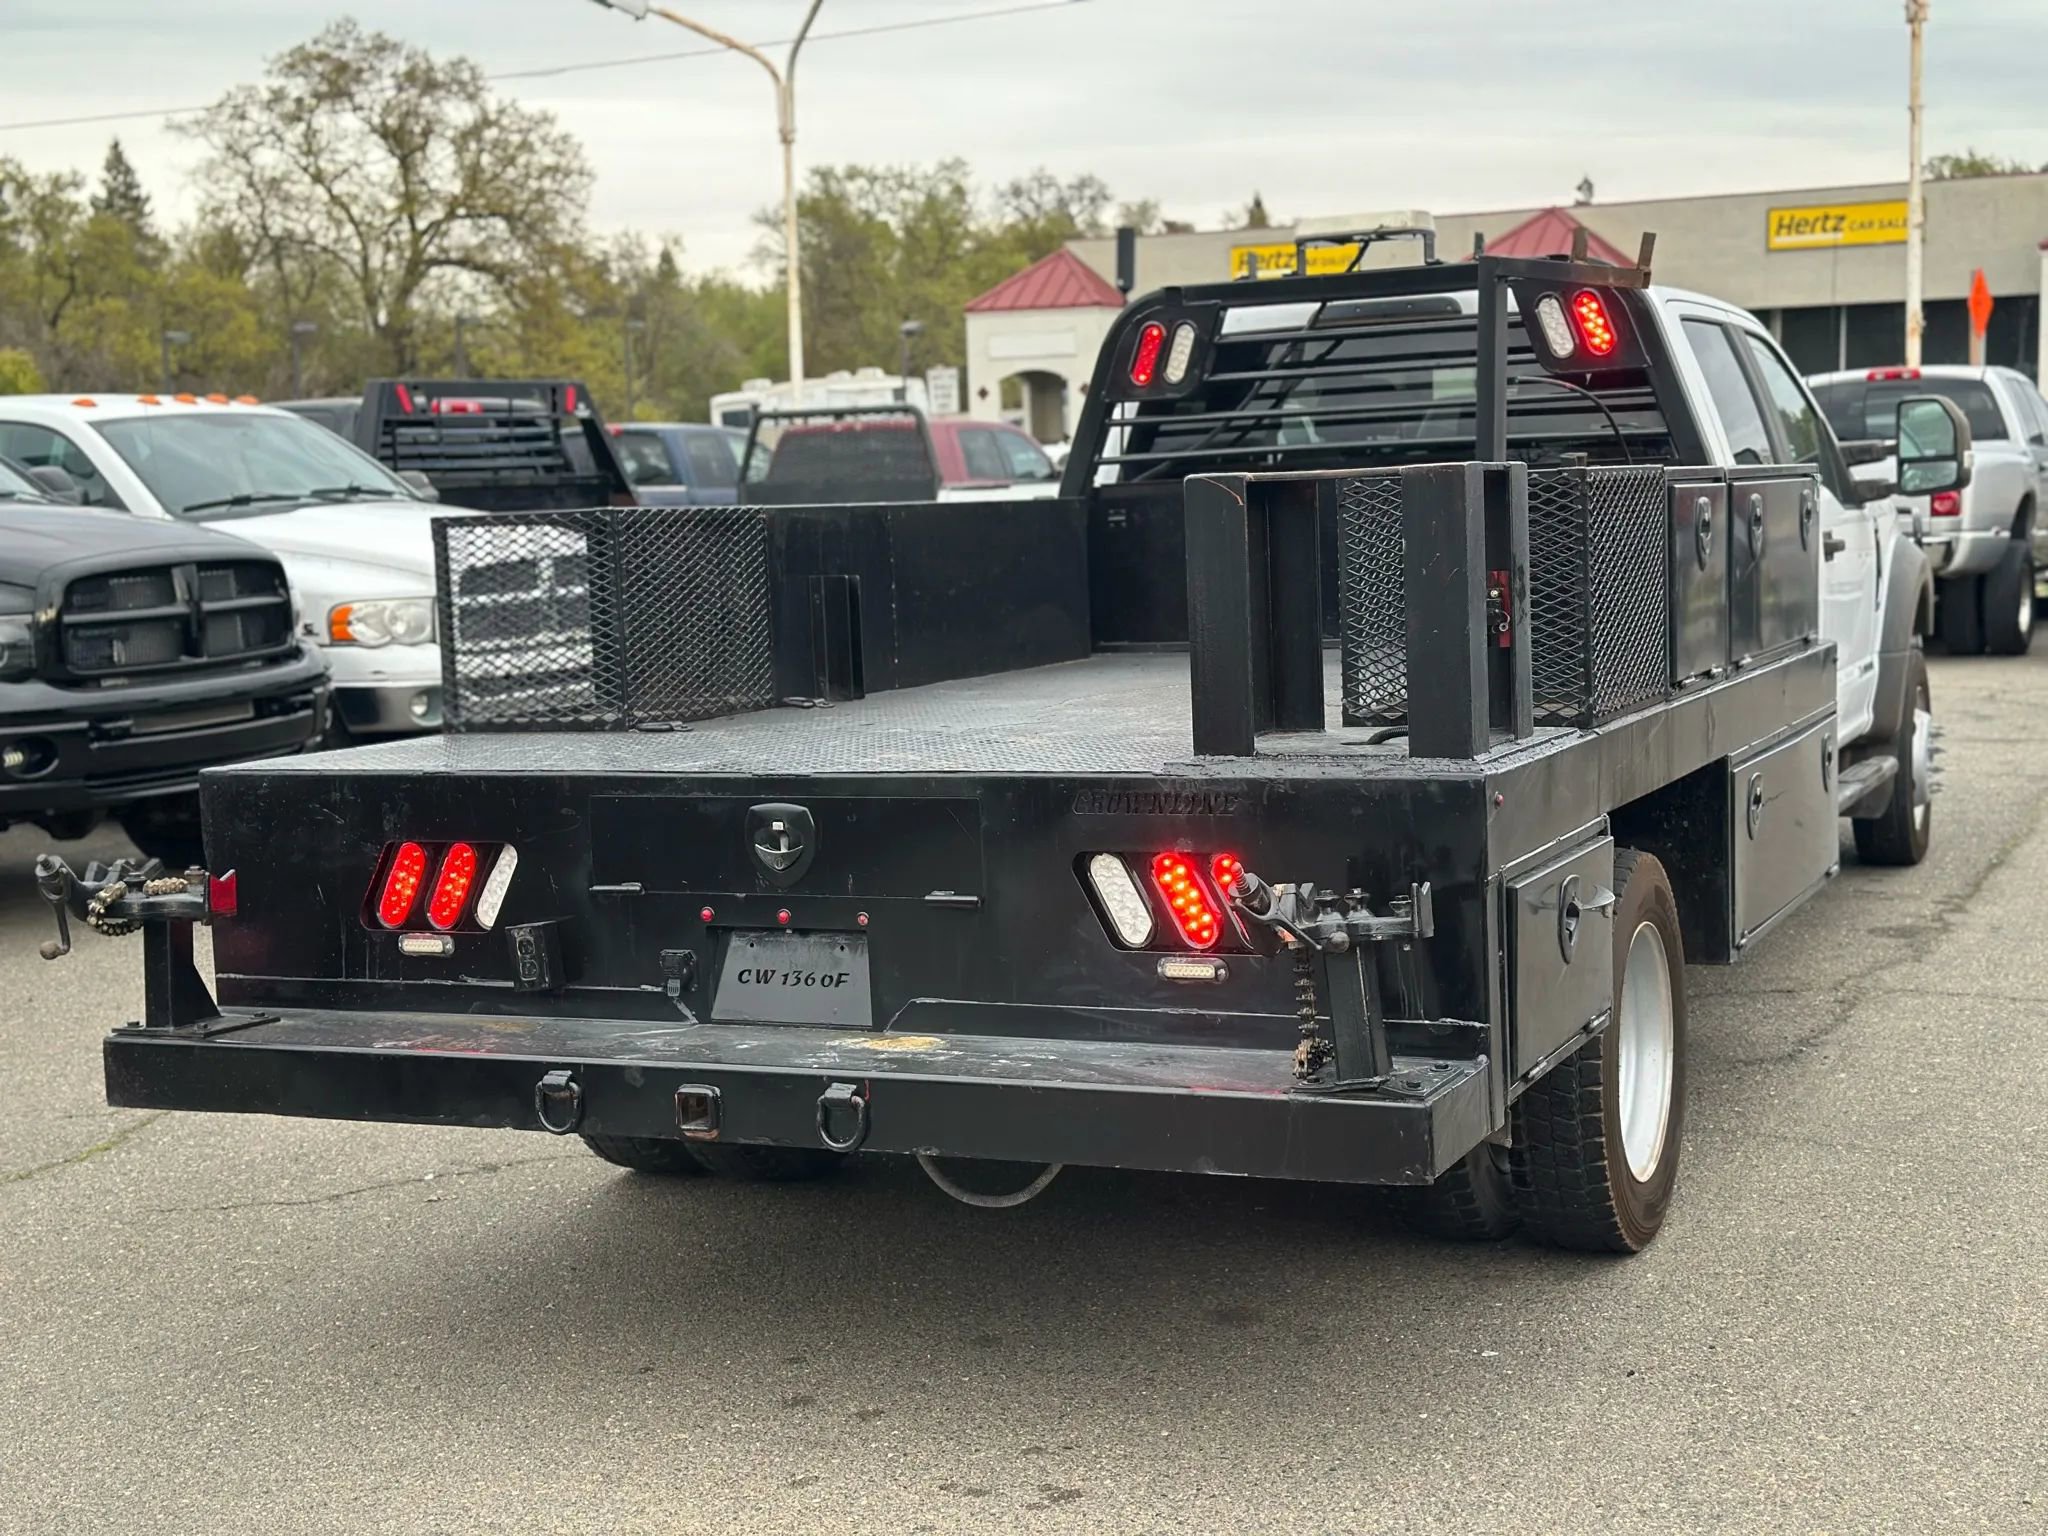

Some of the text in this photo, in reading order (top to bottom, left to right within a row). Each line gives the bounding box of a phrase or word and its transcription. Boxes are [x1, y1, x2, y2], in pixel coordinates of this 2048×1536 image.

[1775, 211, 1909, 236] Hertz CAR SALE
